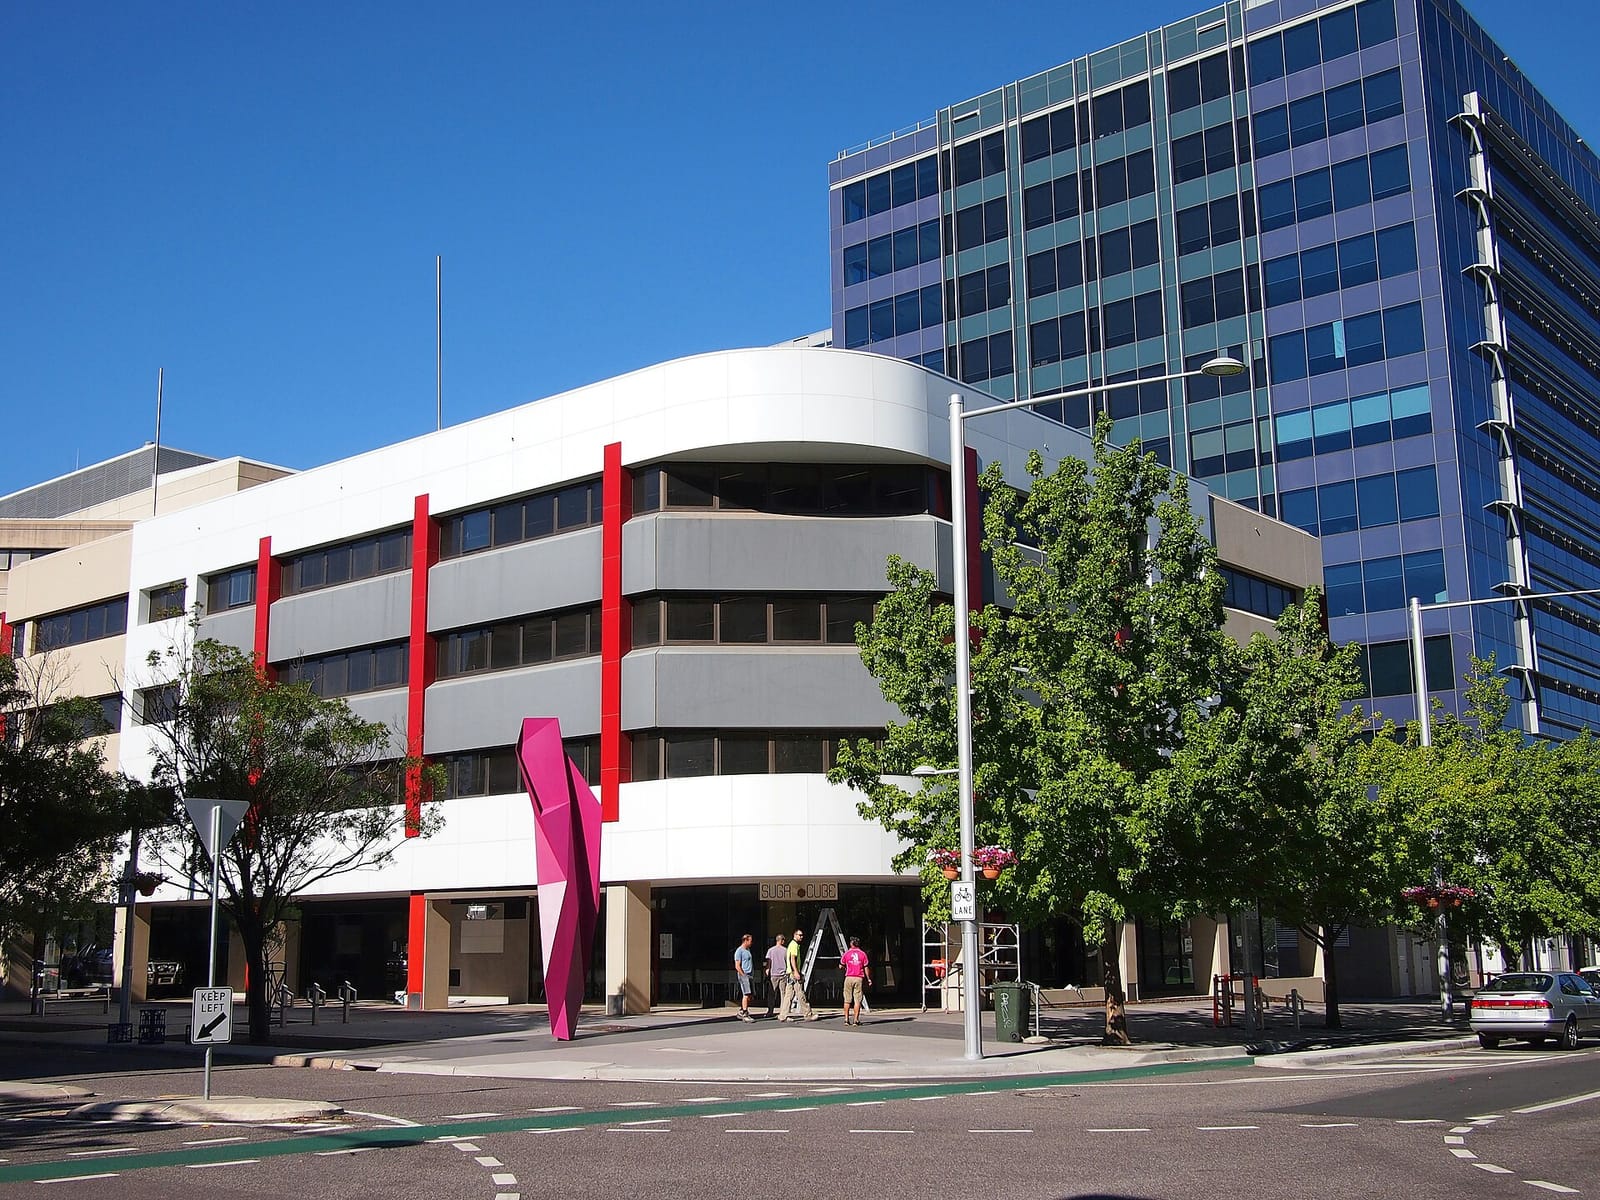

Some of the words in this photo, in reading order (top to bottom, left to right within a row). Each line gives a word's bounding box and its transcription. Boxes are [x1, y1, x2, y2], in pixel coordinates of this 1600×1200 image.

[761, 883, 792, 899] SUGA
[806, 883, 836, 899] CUBE
[954, 905, 973, 915] LANE
[201, 992, 226, 1001] KEEP
[201, 1004, 225, 1012] LEFT
